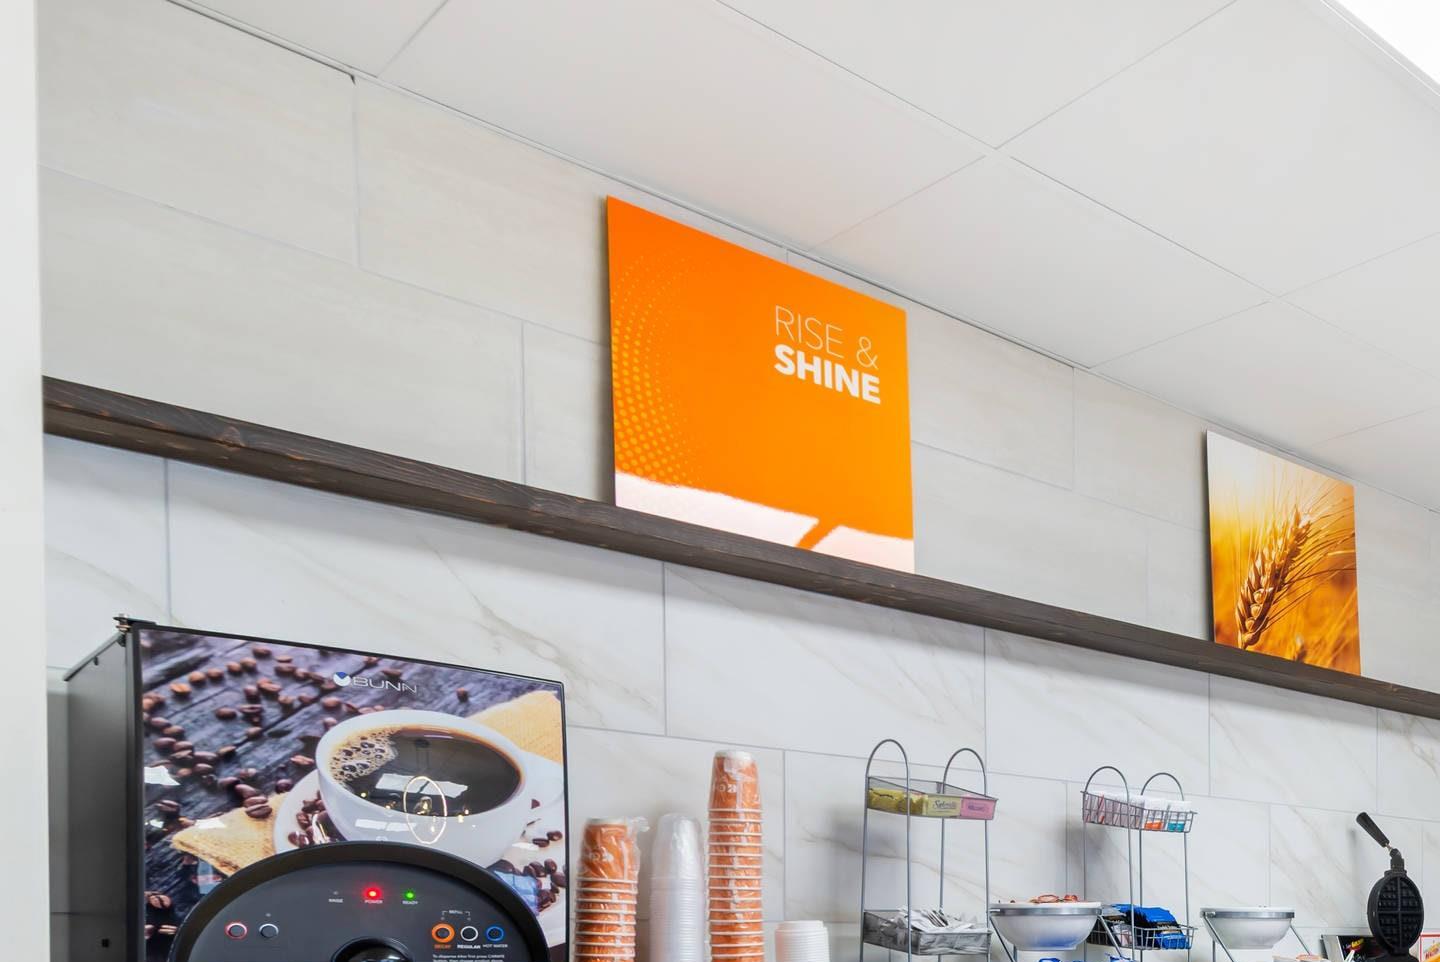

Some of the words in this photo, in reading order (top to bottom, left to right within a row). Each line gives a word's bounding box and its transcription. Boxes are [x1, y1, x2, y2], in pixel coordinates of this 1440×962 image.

[775, 304, 845, 359] RISE
[856, 335, 880, 371] &
[774, 343, 881, 405] SHINE
[352, 676, 417, 694] BUNN
